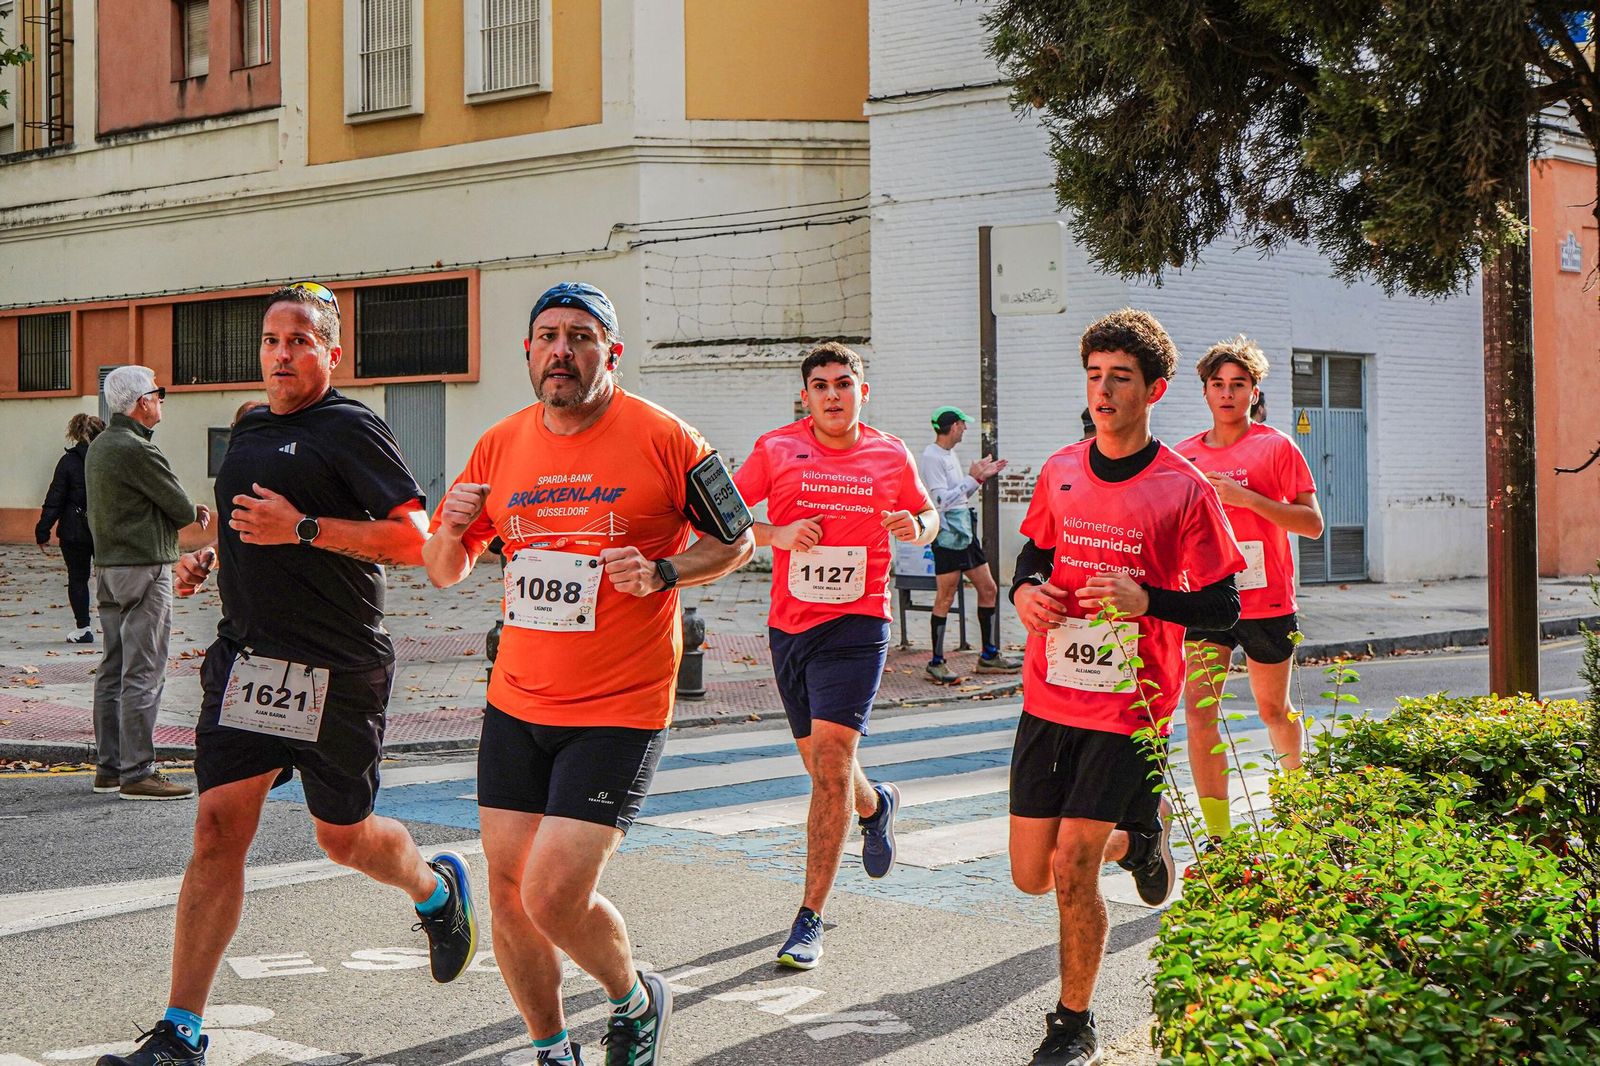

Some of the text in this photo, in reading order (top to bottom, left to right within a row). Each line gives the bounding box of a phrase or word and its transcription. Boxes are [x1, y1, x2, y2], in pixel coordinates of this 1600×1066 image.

[537, 473, 594, 485] SPARDA-BANK
[802, 470, 873, 484] kilómetros de
[1236, 468, 1248, 476] de
[507, 485, 627, 508] BRÜCKENLAUF
[713, 483, 734, 506] 5:05
[801, 482, 873, 496] humanidad
[536, 506, 590, 518] DÜSSELDORF
[796, 499, 874, 515] #CarreraCruzRoja
[1063, 516, 1144, 540] kilómetros de
[1063, 531, 1142, 555] humanidad
[800, 565, 856, 583] 1127
[1060, 555, 1146, 578] #CarreraCruzRoja
[516, 576, 582, 604] 1088
[1064, 642, 1113, 667] 492
[1075, 667, 1101, 675] ALEJANDRO
[241, 681, 308, 712] 1621
[269, 711, 287, 719] BARNA
